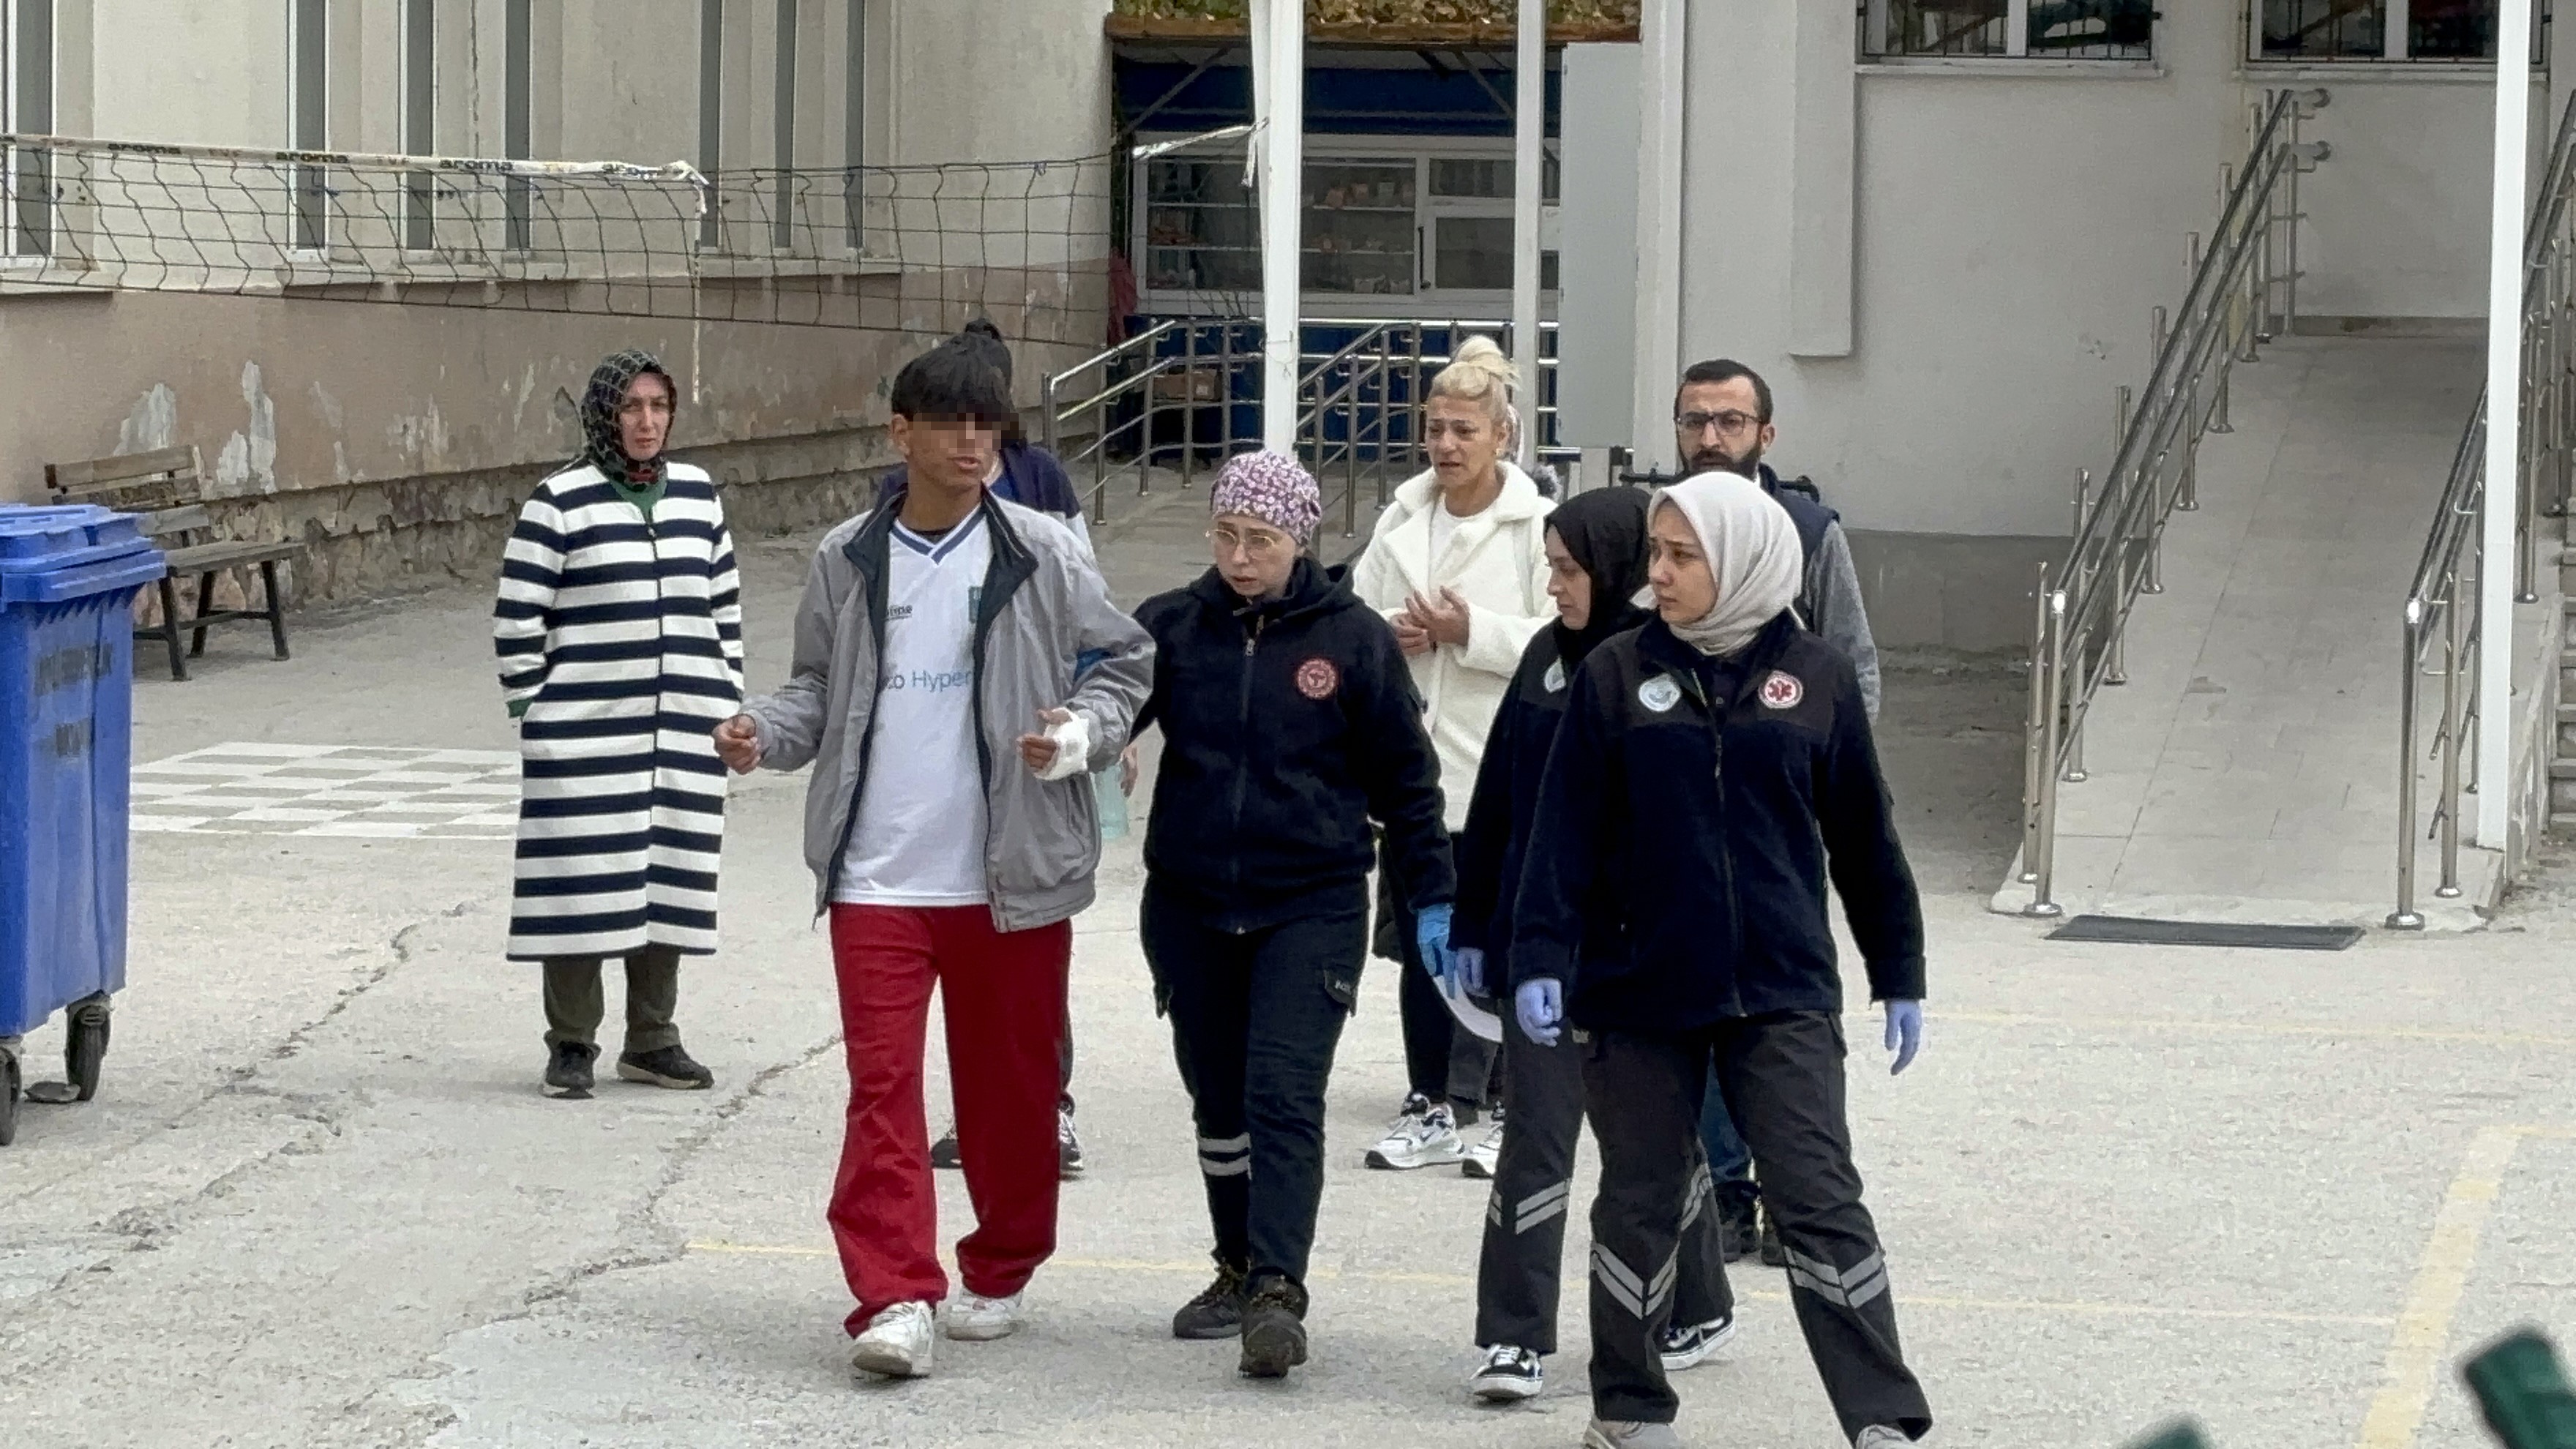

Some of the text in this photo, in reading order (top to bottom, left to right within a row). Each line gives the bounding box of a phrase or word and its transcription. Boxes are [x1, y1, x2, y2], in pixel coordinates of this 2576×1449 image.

[108, 143, 181, 154] aroma
[276, 151, 349, 163] aroma
[440, 160, 513, 171] aroma
[912, 670, 972, 693] Hyper
